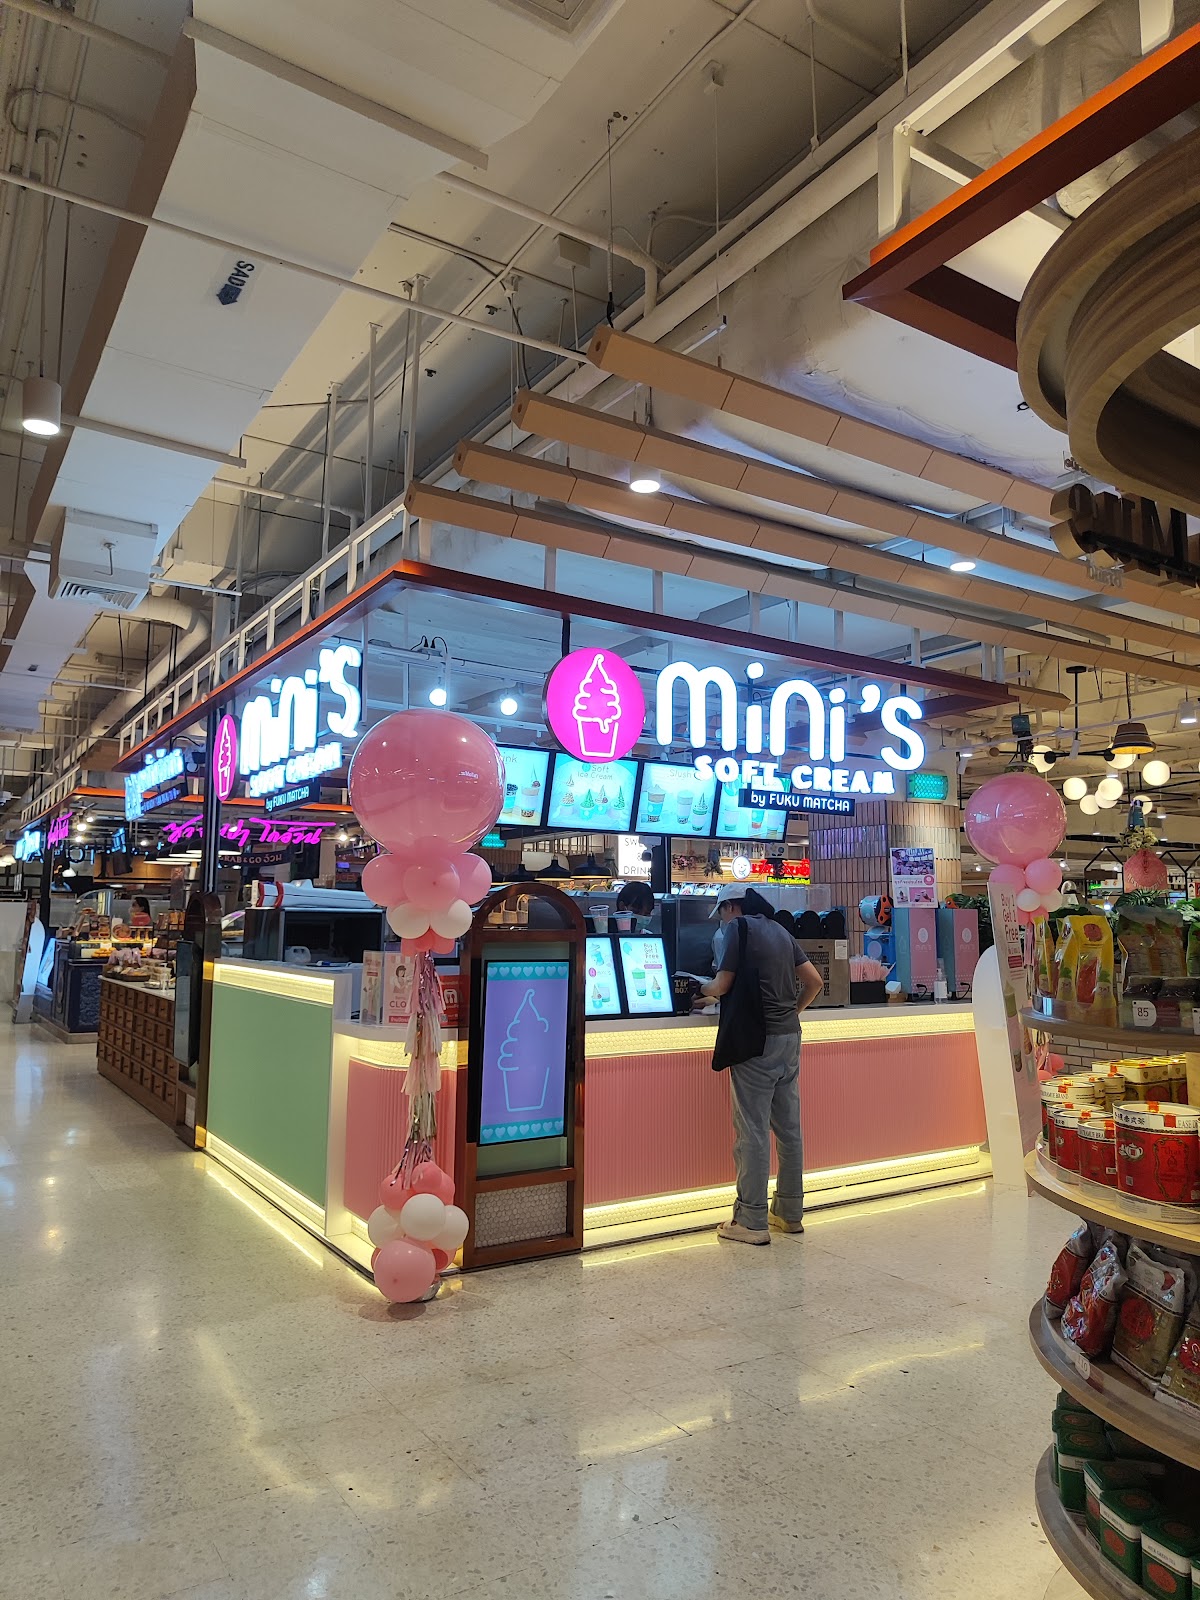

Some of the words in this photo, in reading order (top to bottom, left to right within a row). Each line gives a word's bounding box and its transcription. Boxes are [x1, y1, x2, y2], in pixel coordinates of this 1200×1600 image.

[228, 260, 255, 287] SAD
[590, 772, 613, 780] Cream
[592, 765, 609, 773] Soft
[694, 755, 779, 786] SOFT
[790, 765, 895, 794] CREAM
[266, 797, 273, 811] by
[273, 792, 286, 807] FUKU
[286, 786, 310, 804] MATCHA
[751, 791, 766, 807] by
[769, 793, 799, 808] FUKU
[803, 797, 850, 812] MATCHA
[1002, 908, 1012, 922] Get
[1005, 924, 1019, 940] Free
[389, 1000, 407, 1008] CLO
[1137, 1007, 1149, 1018] 85
